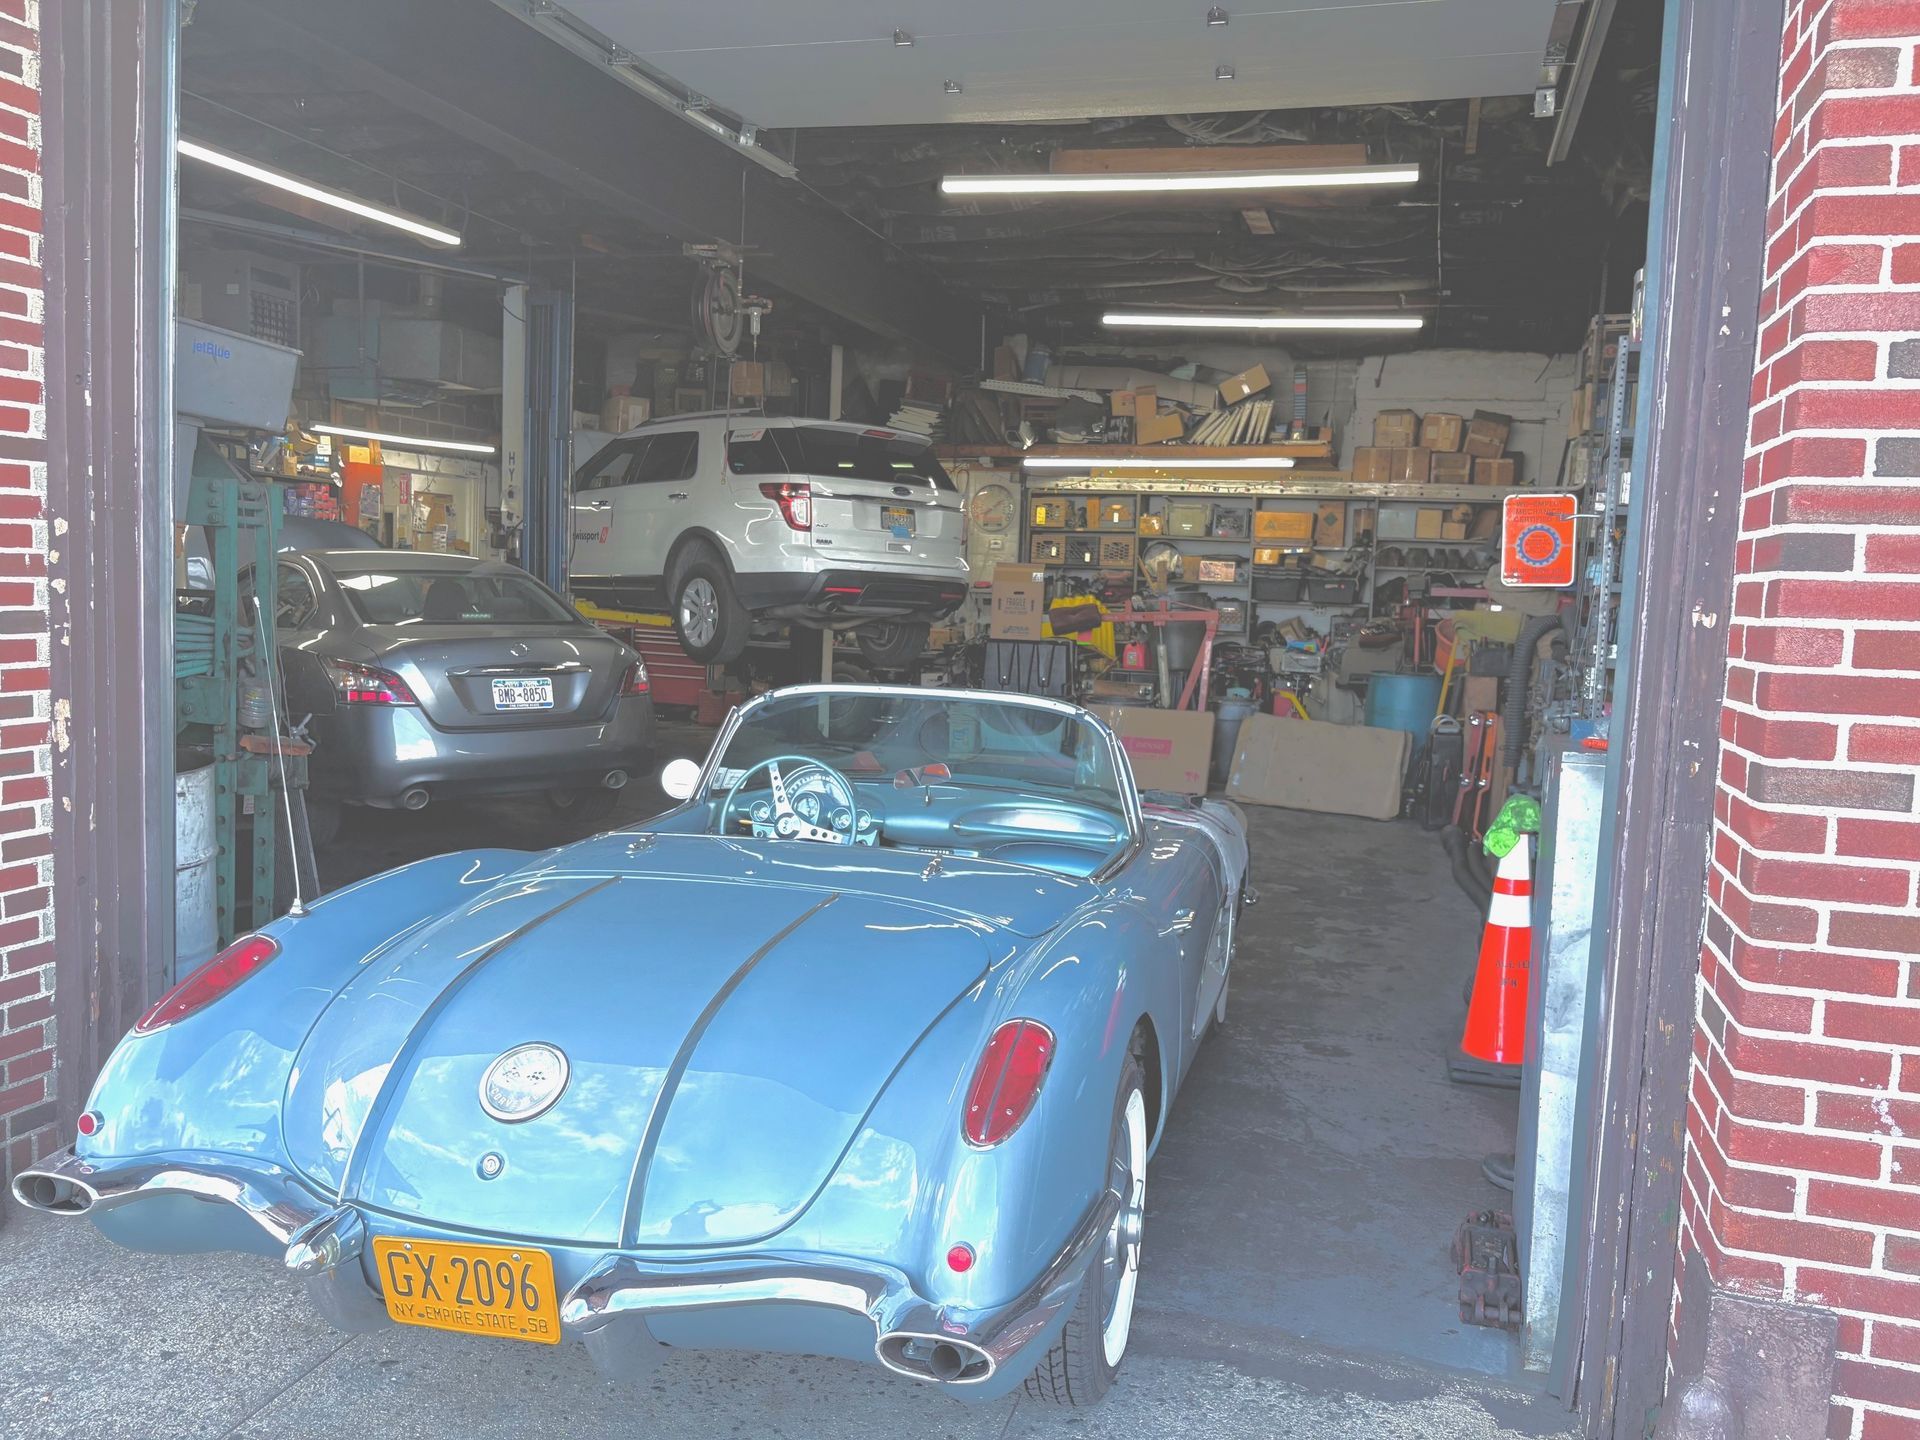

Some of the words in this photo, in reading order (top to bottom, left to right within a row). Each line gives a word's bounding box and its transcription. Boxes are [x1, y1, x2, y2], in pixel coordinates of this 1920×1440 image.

[192, 341, 230, 359] jetBlue
[523, 687, 547, 702] 8850
[394, 1303, 415, 1319] NY
[425, 1307, 473, 1326] EMPIRE
[476, 1312, 517, 1330] STATE
[528, 1319, 549, 1334] 58
